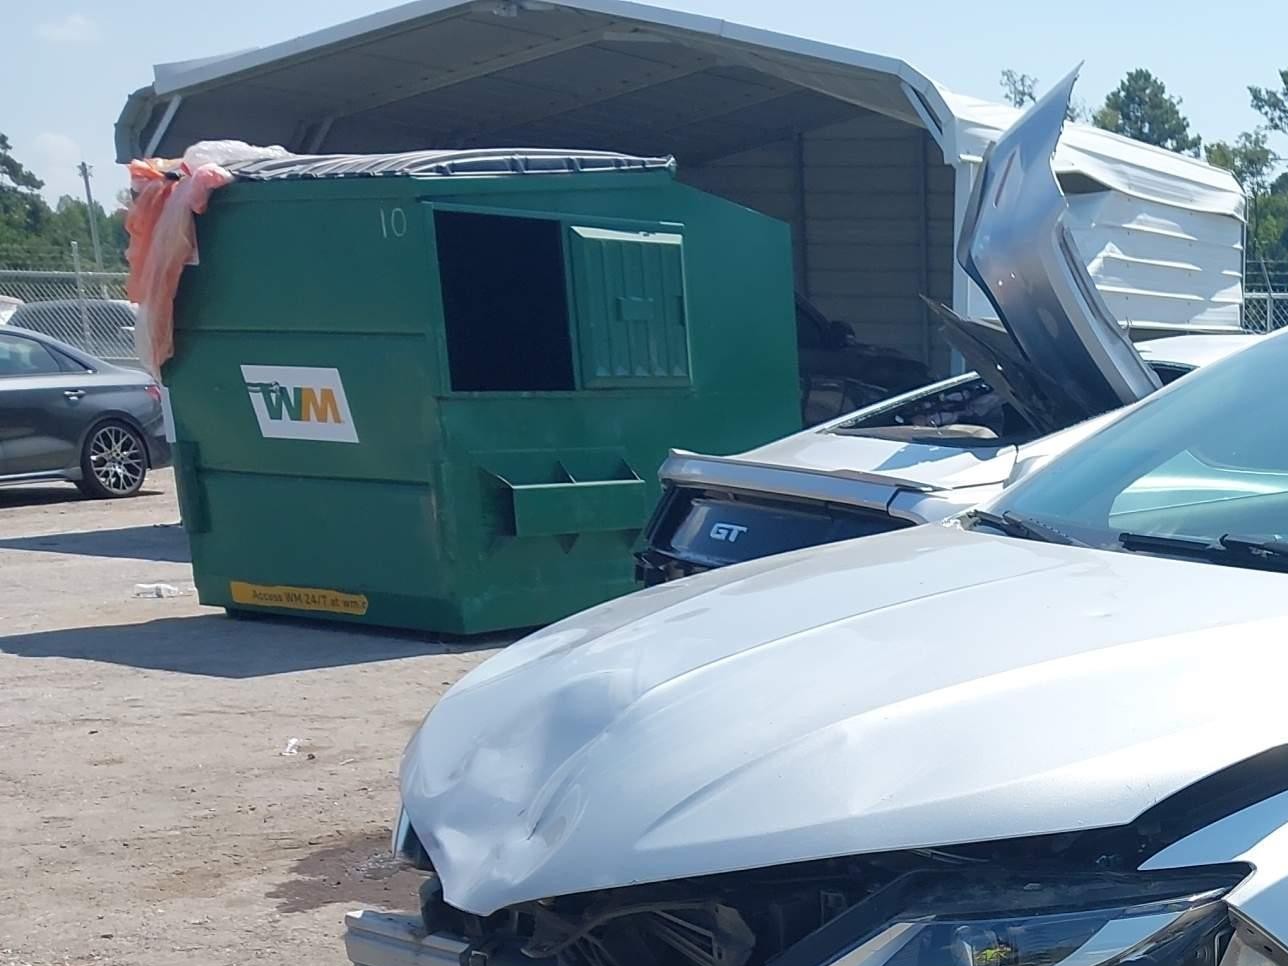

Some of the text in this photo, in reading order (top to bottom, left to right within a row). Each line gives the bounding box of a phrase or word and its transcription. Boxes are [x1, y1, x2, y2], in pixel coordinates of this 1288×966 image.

[379, 207, 407, 239] 10
[248, 381, 343, 424] WM
[710, 523, 748, 542] GT
[252, 590, 283, 602] Access
[285, 591, 303, 604] WM
